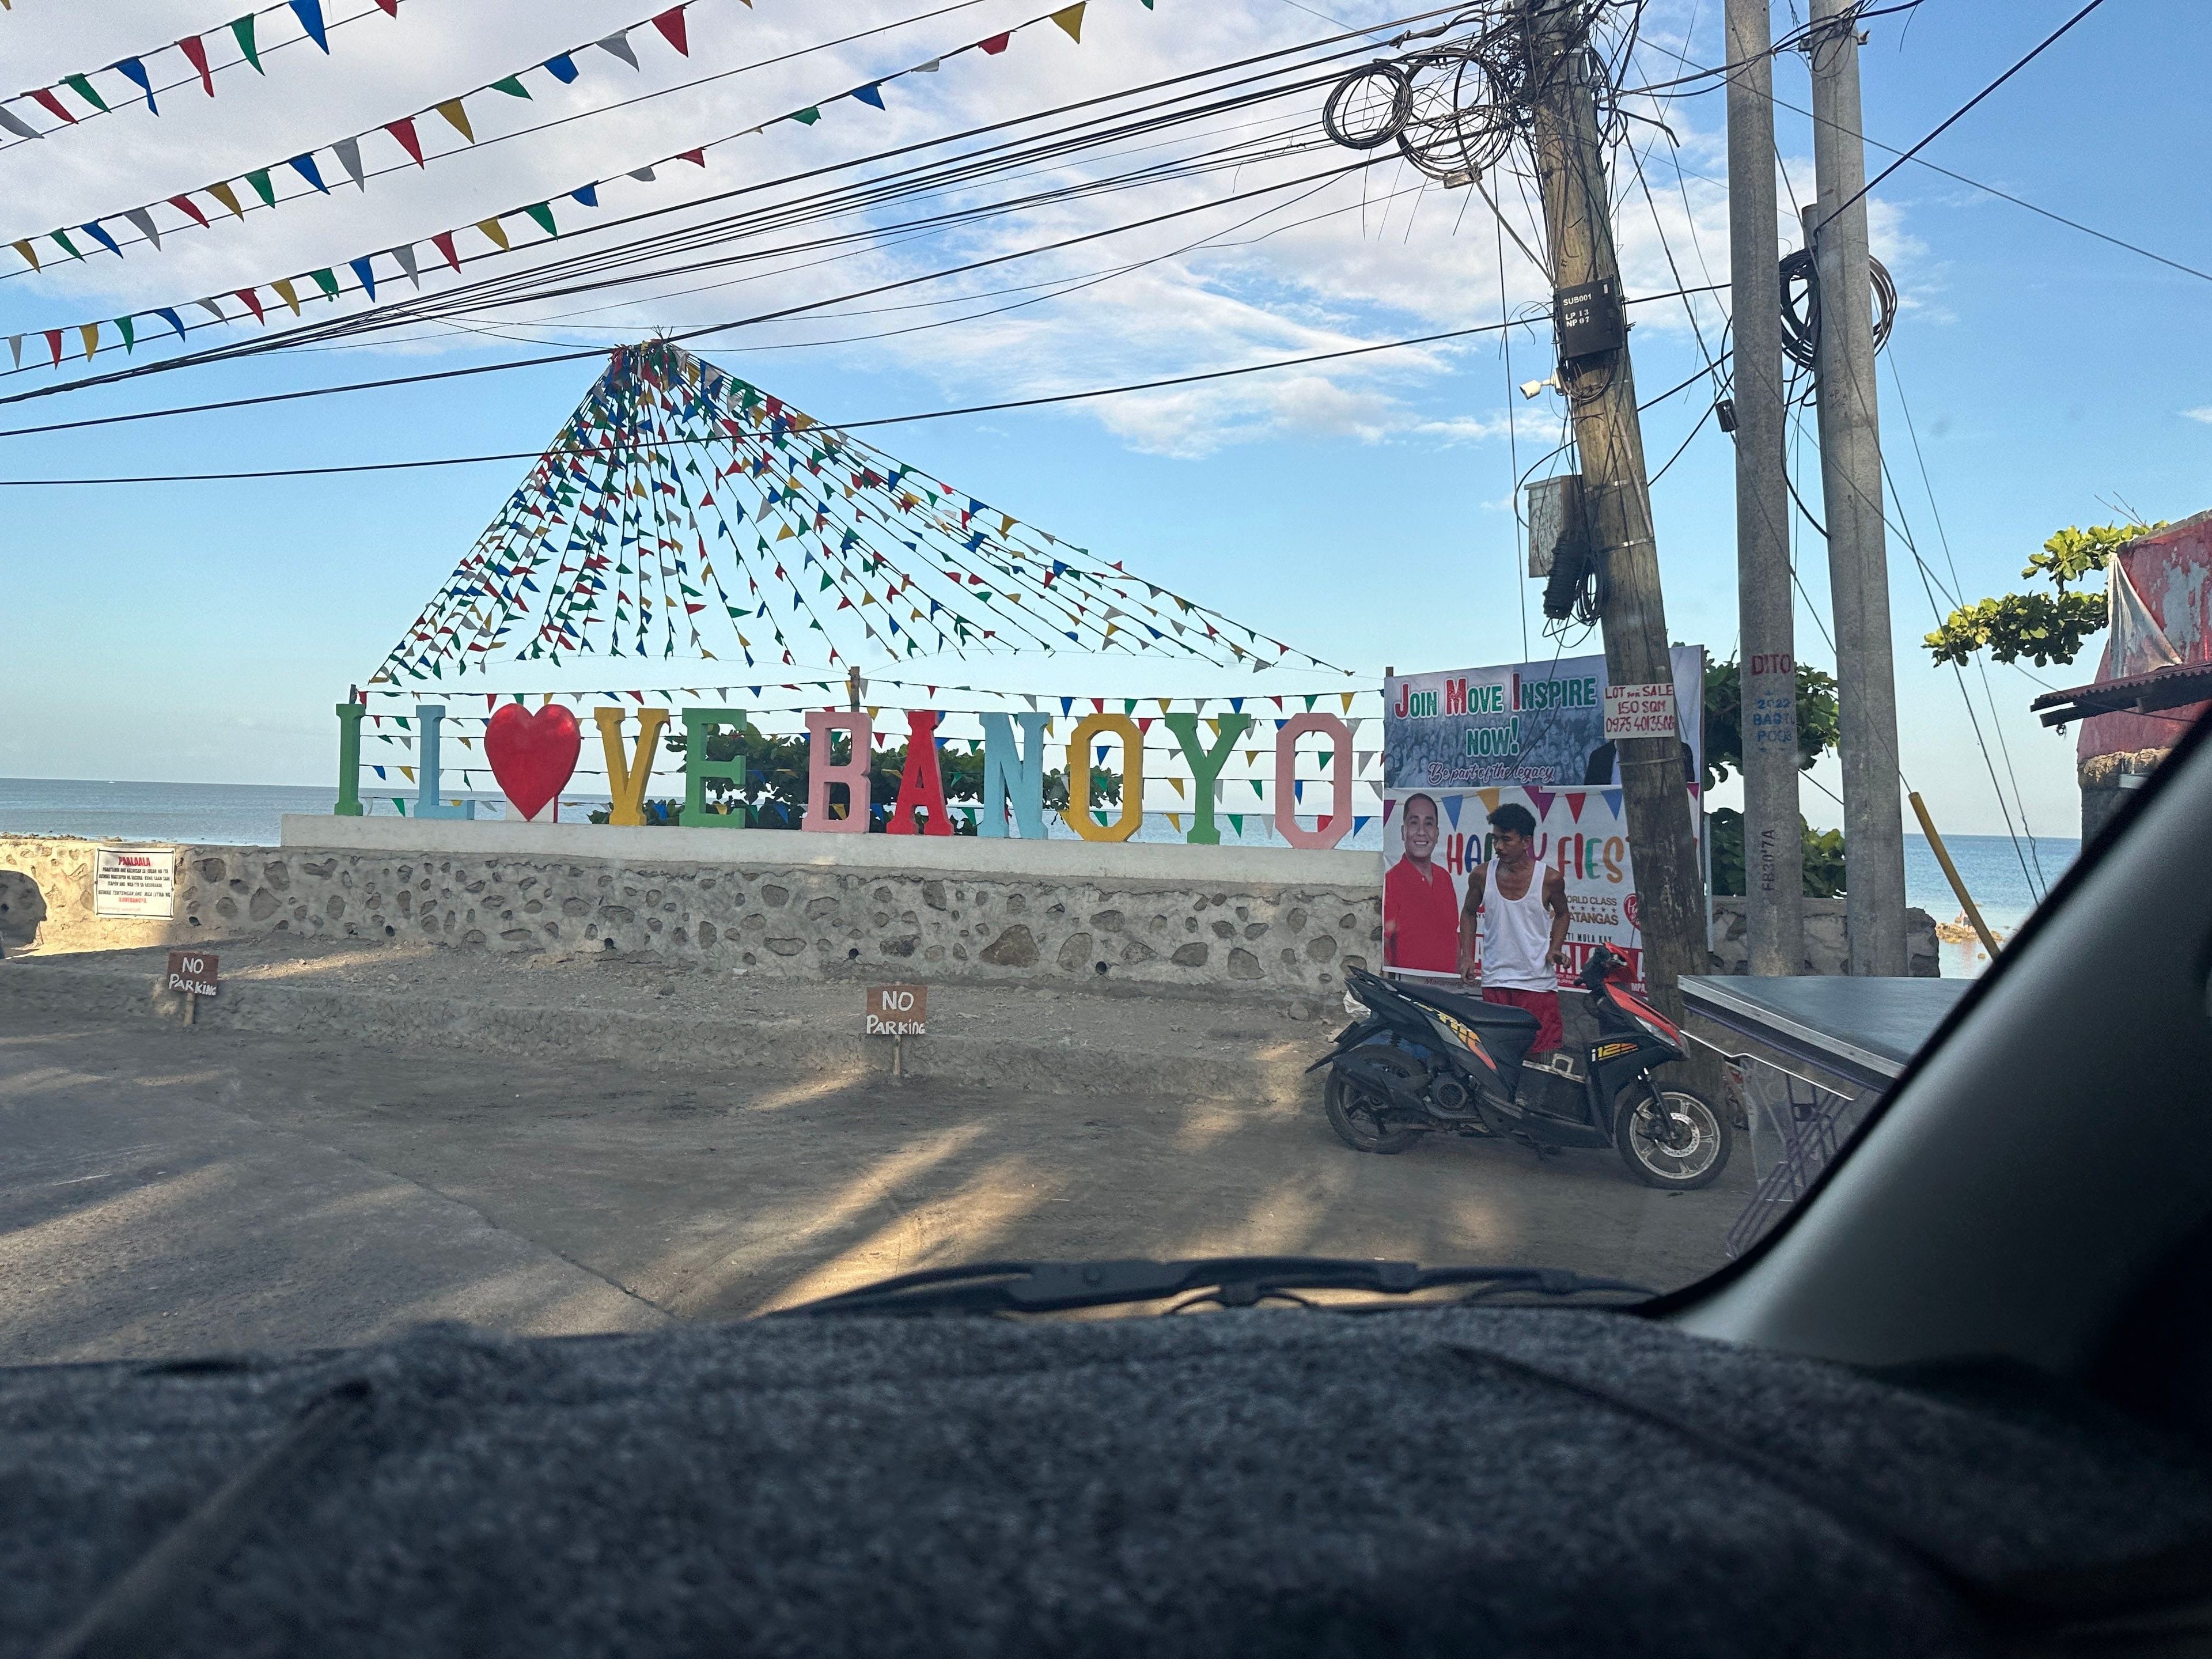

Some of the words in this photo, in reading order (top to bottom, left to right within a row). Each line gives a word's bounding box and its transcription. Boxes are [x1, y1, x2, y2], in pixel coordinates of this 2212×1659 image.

[1563, 293, 1592, 306] SUB001
[1565, 312, 1576, 321] LP
[1566, 319, 1578, 328] NP
[1752, 654, 1791, 676] DITO
[1605, 686, 1626, 699] LOT
[1642, 684, 1673, 696] SALE
[1618, 700, 1639, 714] 150
[1642, 700, 1666, 713] SQM
[1606, 716, 1631, 733] 0975
[1467, 716, 1519, 756] NOW!
[334, 703, 365, 816] I
[802, 710, 1353, 849] BANOYO
[1429, 762, 1450, 785] Be
[1450, 763, 1475, 784] part
[1478, 764, 1491, 782] of
[1491, 762, 1512, 779] the
[1513, 763, 1555, 784] legacy
[118, 856, 151, 866] PAALAALA
[1566, 895, 1588, 904] ORLD
[1590, 897, 1617, 906] CLASS
[1569, 912, 1619, 926] ATANGAS
[1577, 933, 1595, 943] MULA
[182, 957, 204, 974] NO
[882, 990, 914, 1012] NO
